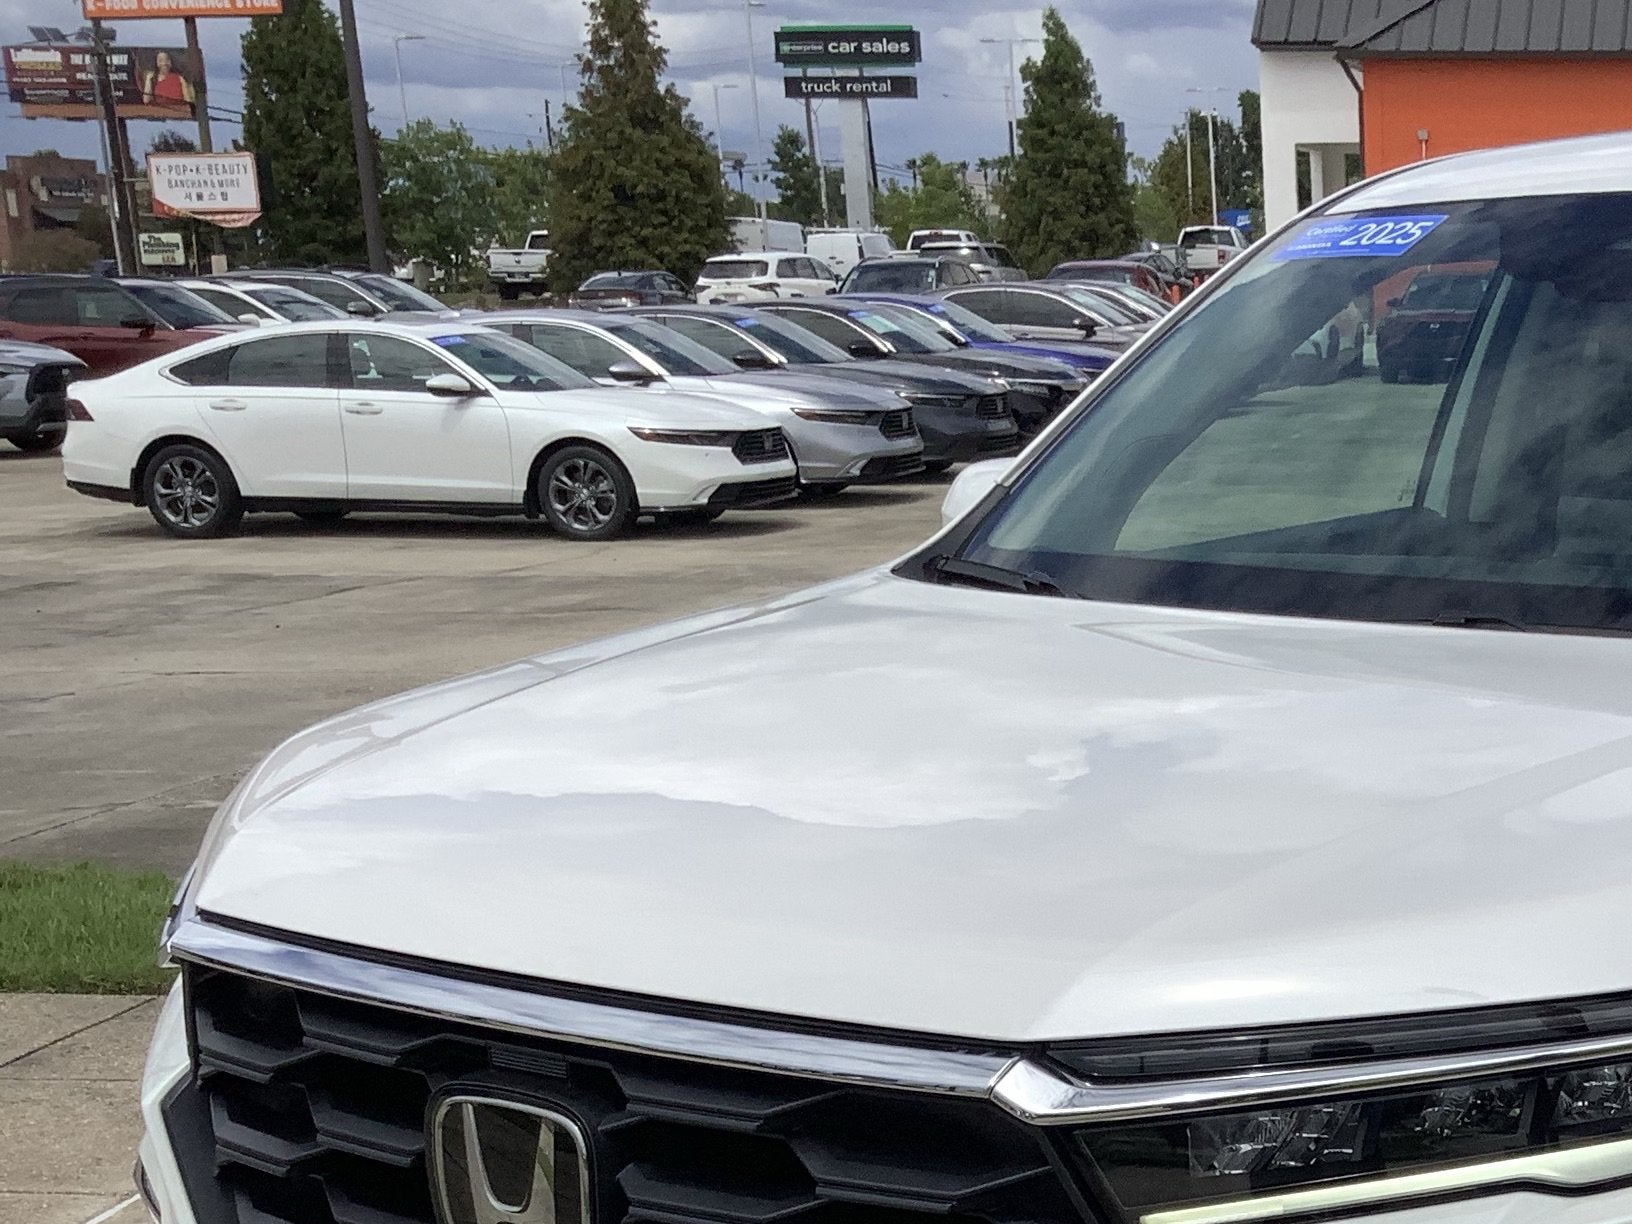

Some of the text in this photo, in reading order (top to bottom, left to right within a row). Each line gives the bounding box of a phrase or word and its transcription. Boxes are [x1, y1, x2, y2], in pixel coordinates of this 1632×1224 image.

[828, 41, 858, 53] car
[862, 37, 910, 53] sales
[801, 79, 892, 93] truck rental
[1339, 221, 1434, 246] 2025
